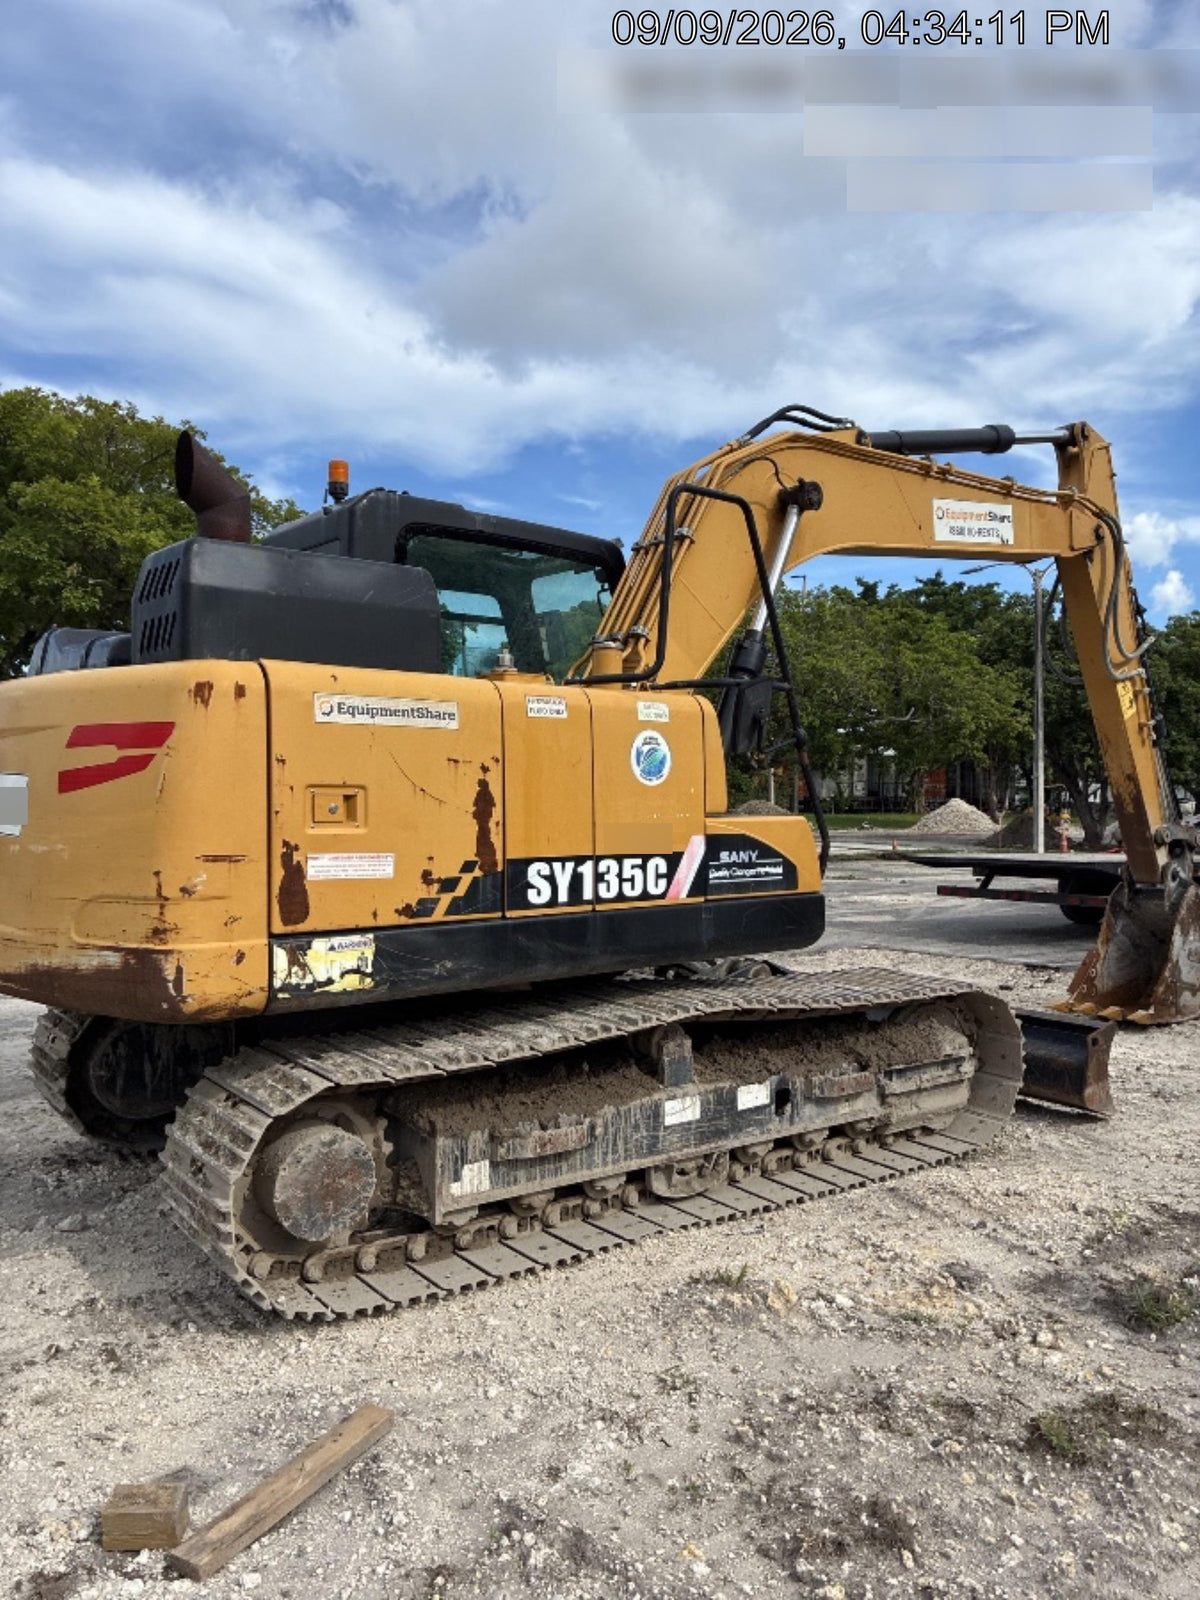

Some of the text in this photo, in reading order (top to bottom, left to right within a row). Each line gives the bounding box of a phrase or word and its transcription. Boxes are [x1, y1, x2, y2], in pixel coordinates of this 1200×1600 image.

[337, 702, 456, 721] EquipmentShare
[720, 850, 758, 863] SANY
[527, 856, 668, 905] SY135C
